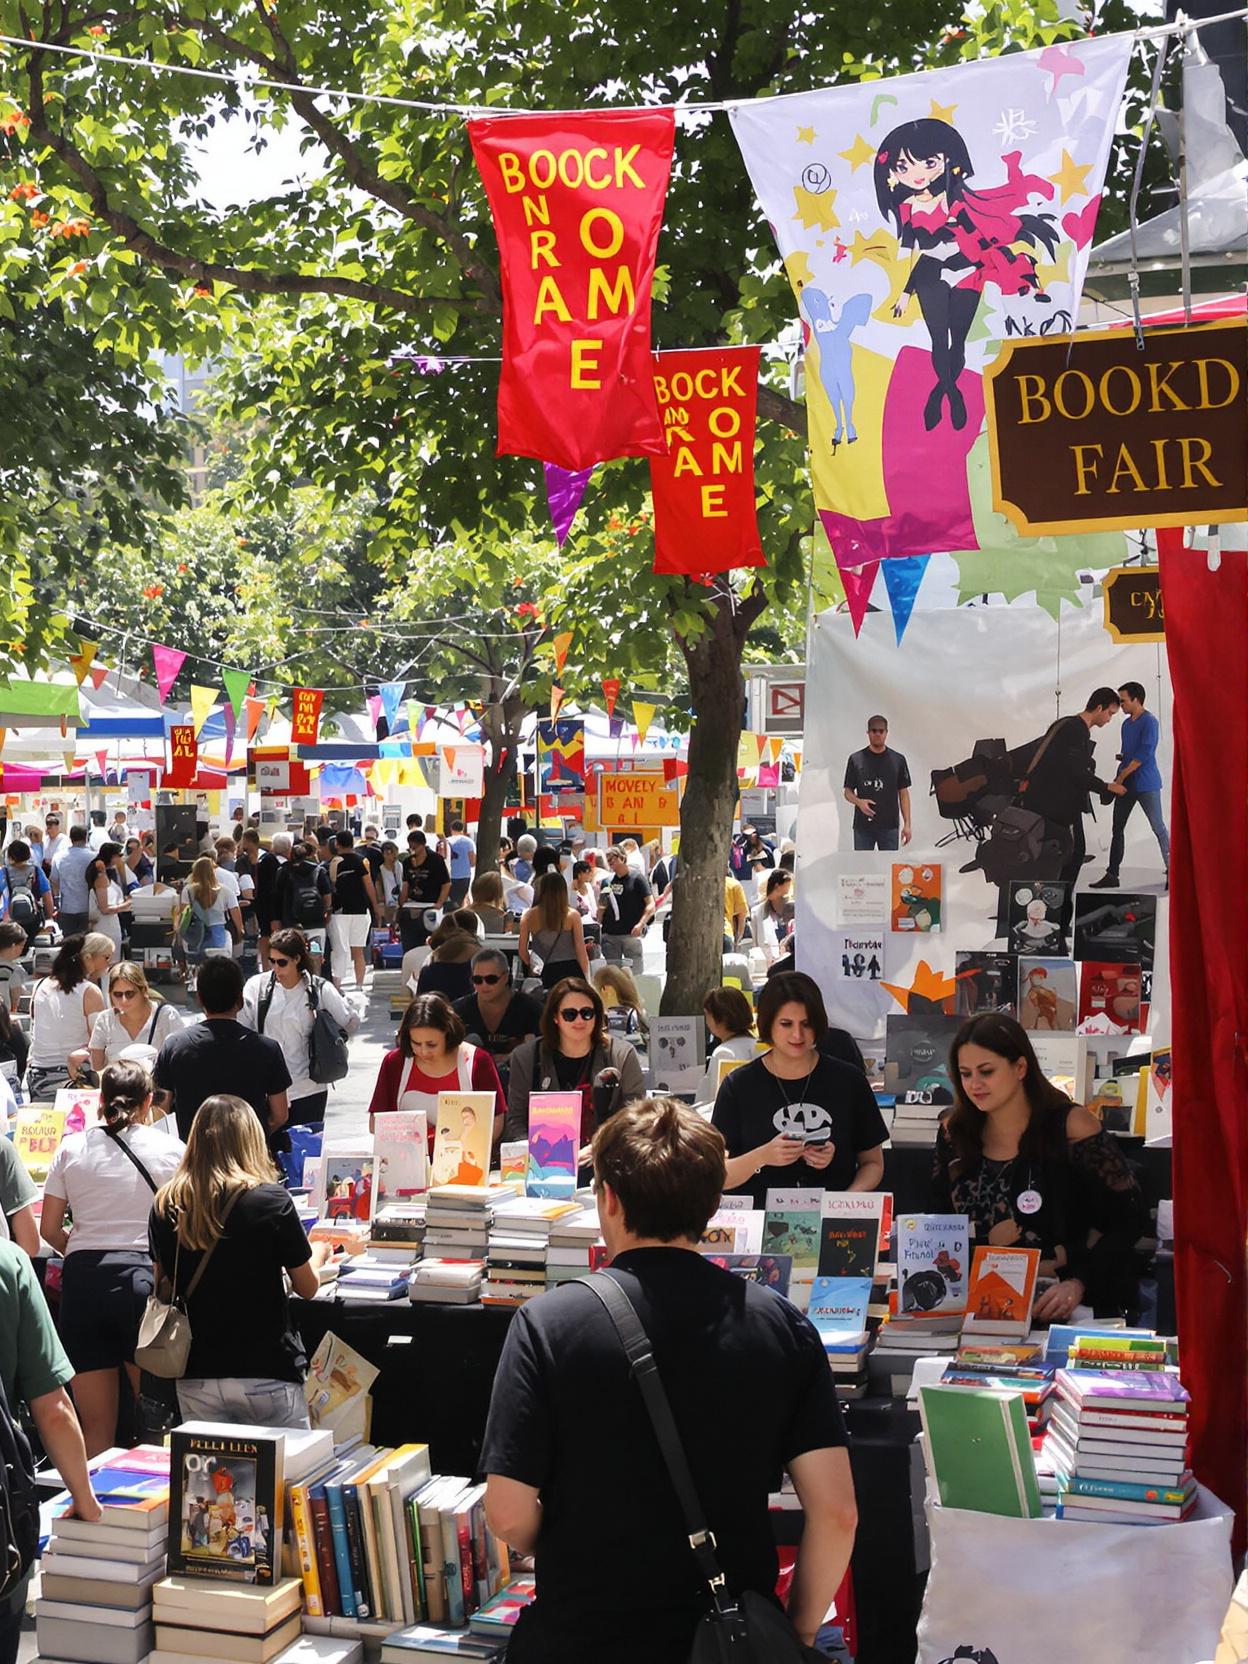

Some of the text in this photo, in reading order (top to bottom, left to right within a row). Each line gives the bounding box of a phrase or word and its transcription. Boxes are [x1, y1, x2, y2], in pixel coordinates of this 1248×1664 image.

[498, 143, 646, 193] BOOCK
[653, 366, 747, 404] BOCK
[1013, 357, 1241, 426] BOOKD
[1068, 437, 1224, 496] FAIR
